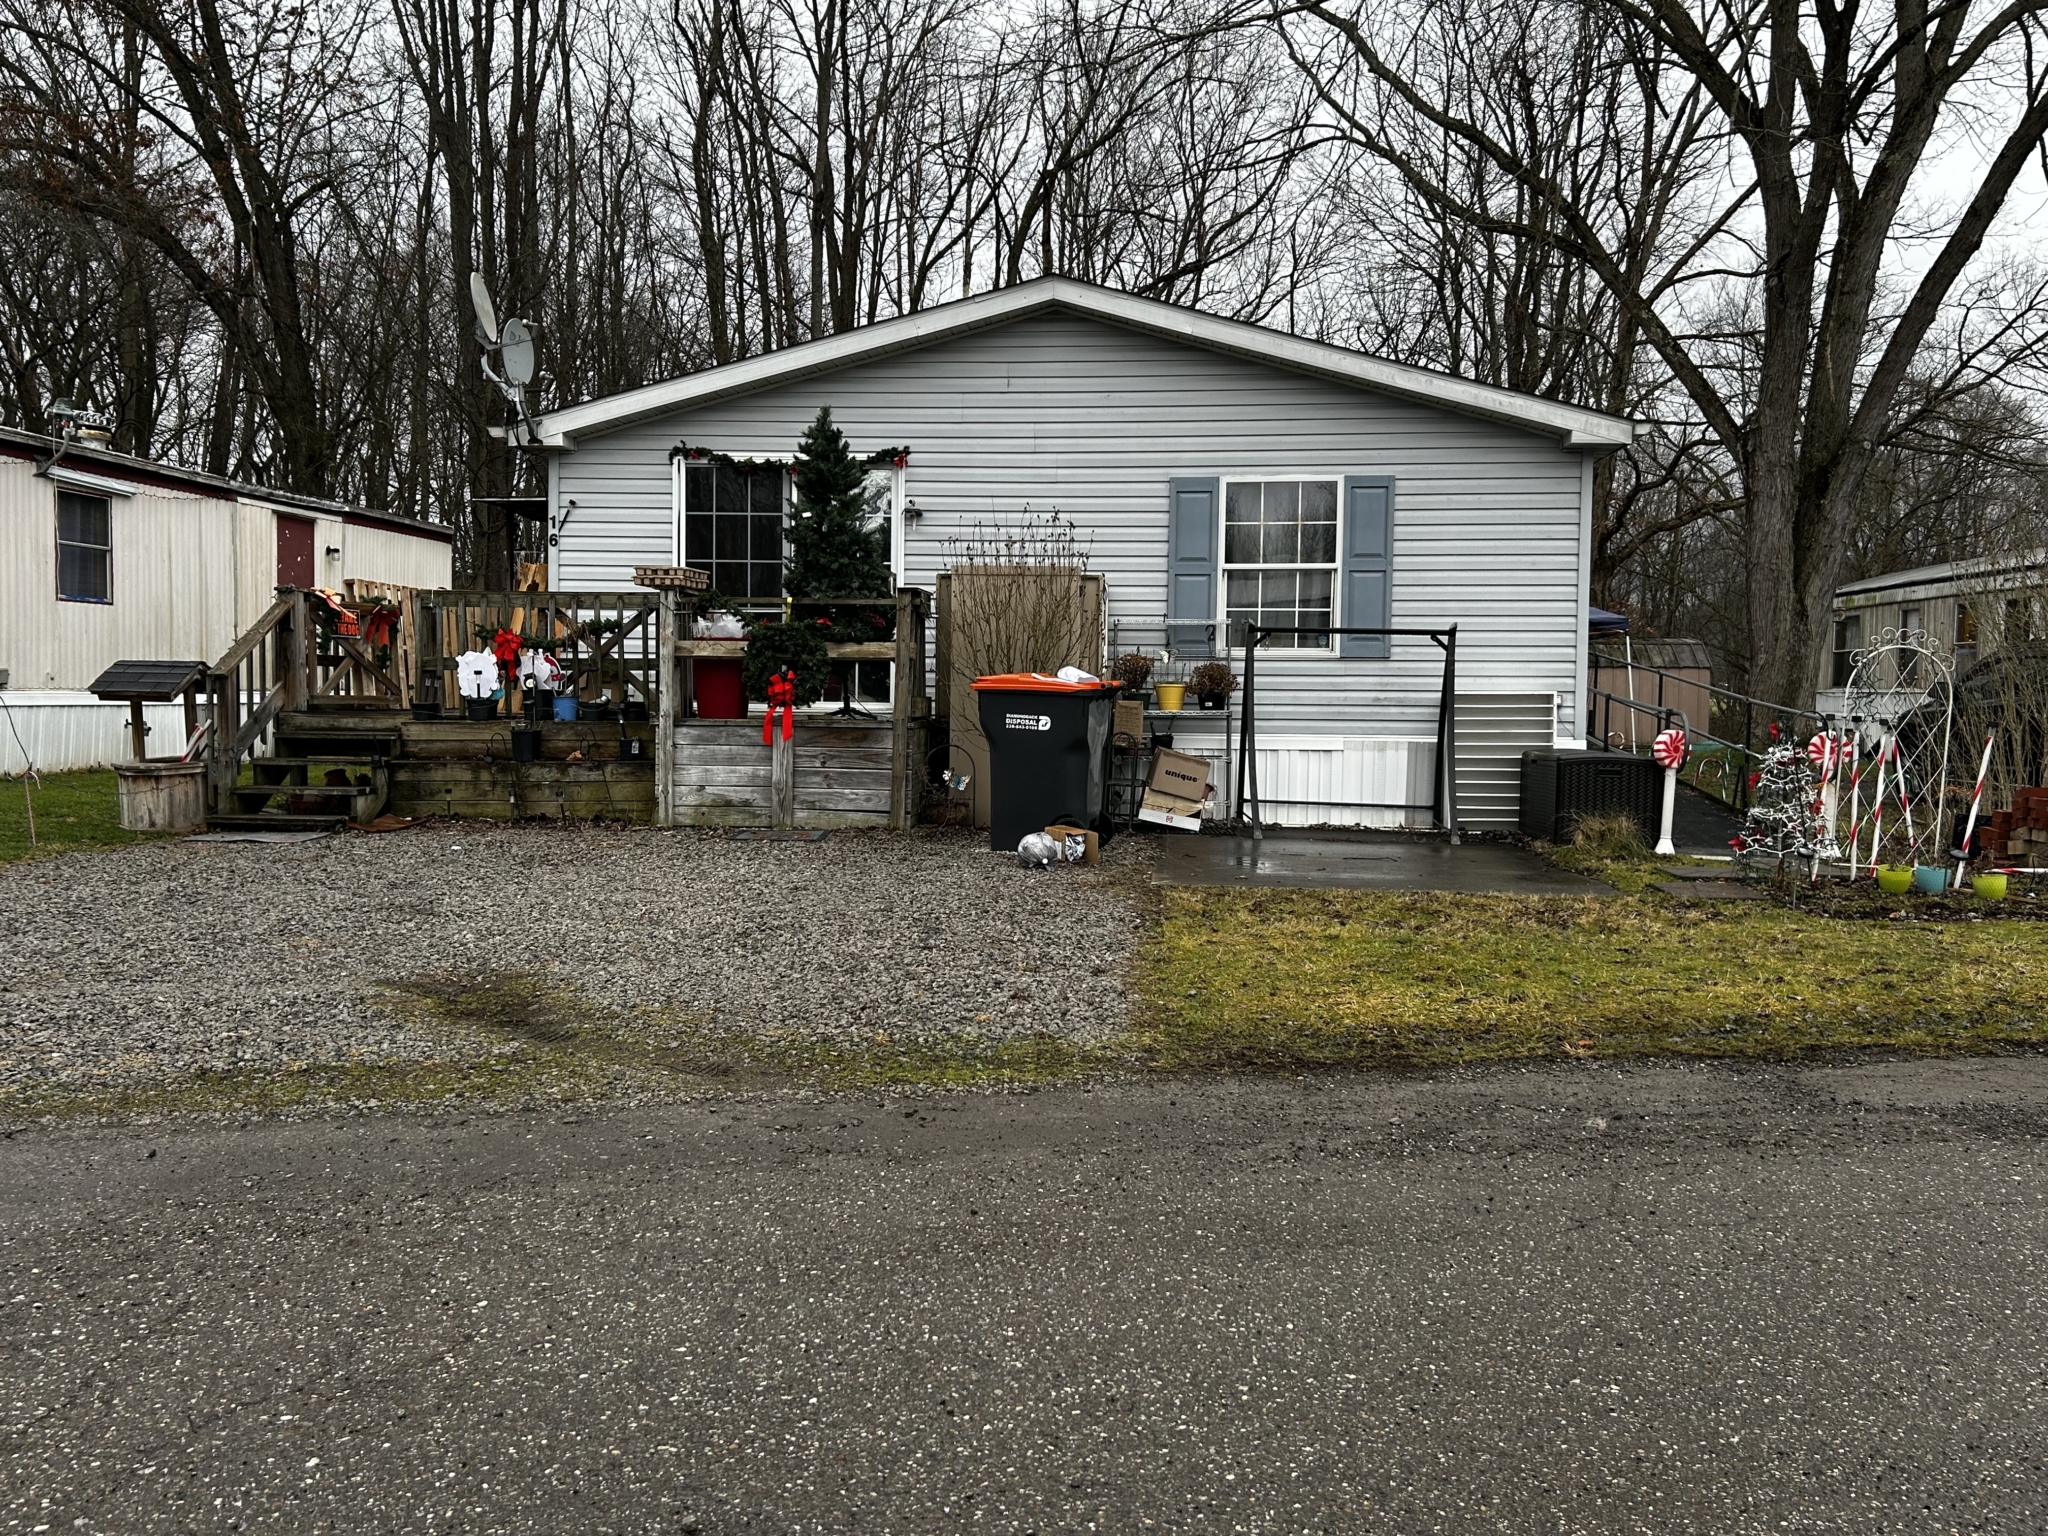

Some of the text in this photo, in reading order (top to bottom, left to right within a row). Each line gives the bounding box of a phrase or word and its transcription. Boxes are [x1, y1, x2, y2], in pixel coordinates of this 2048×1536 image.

[549, 515, 558, 547] 16
[348, 624, 359, 635] DOG
[1005, 718, 1038, 726] DISPOSAL
[1165, 769, 1198, 783] unique
